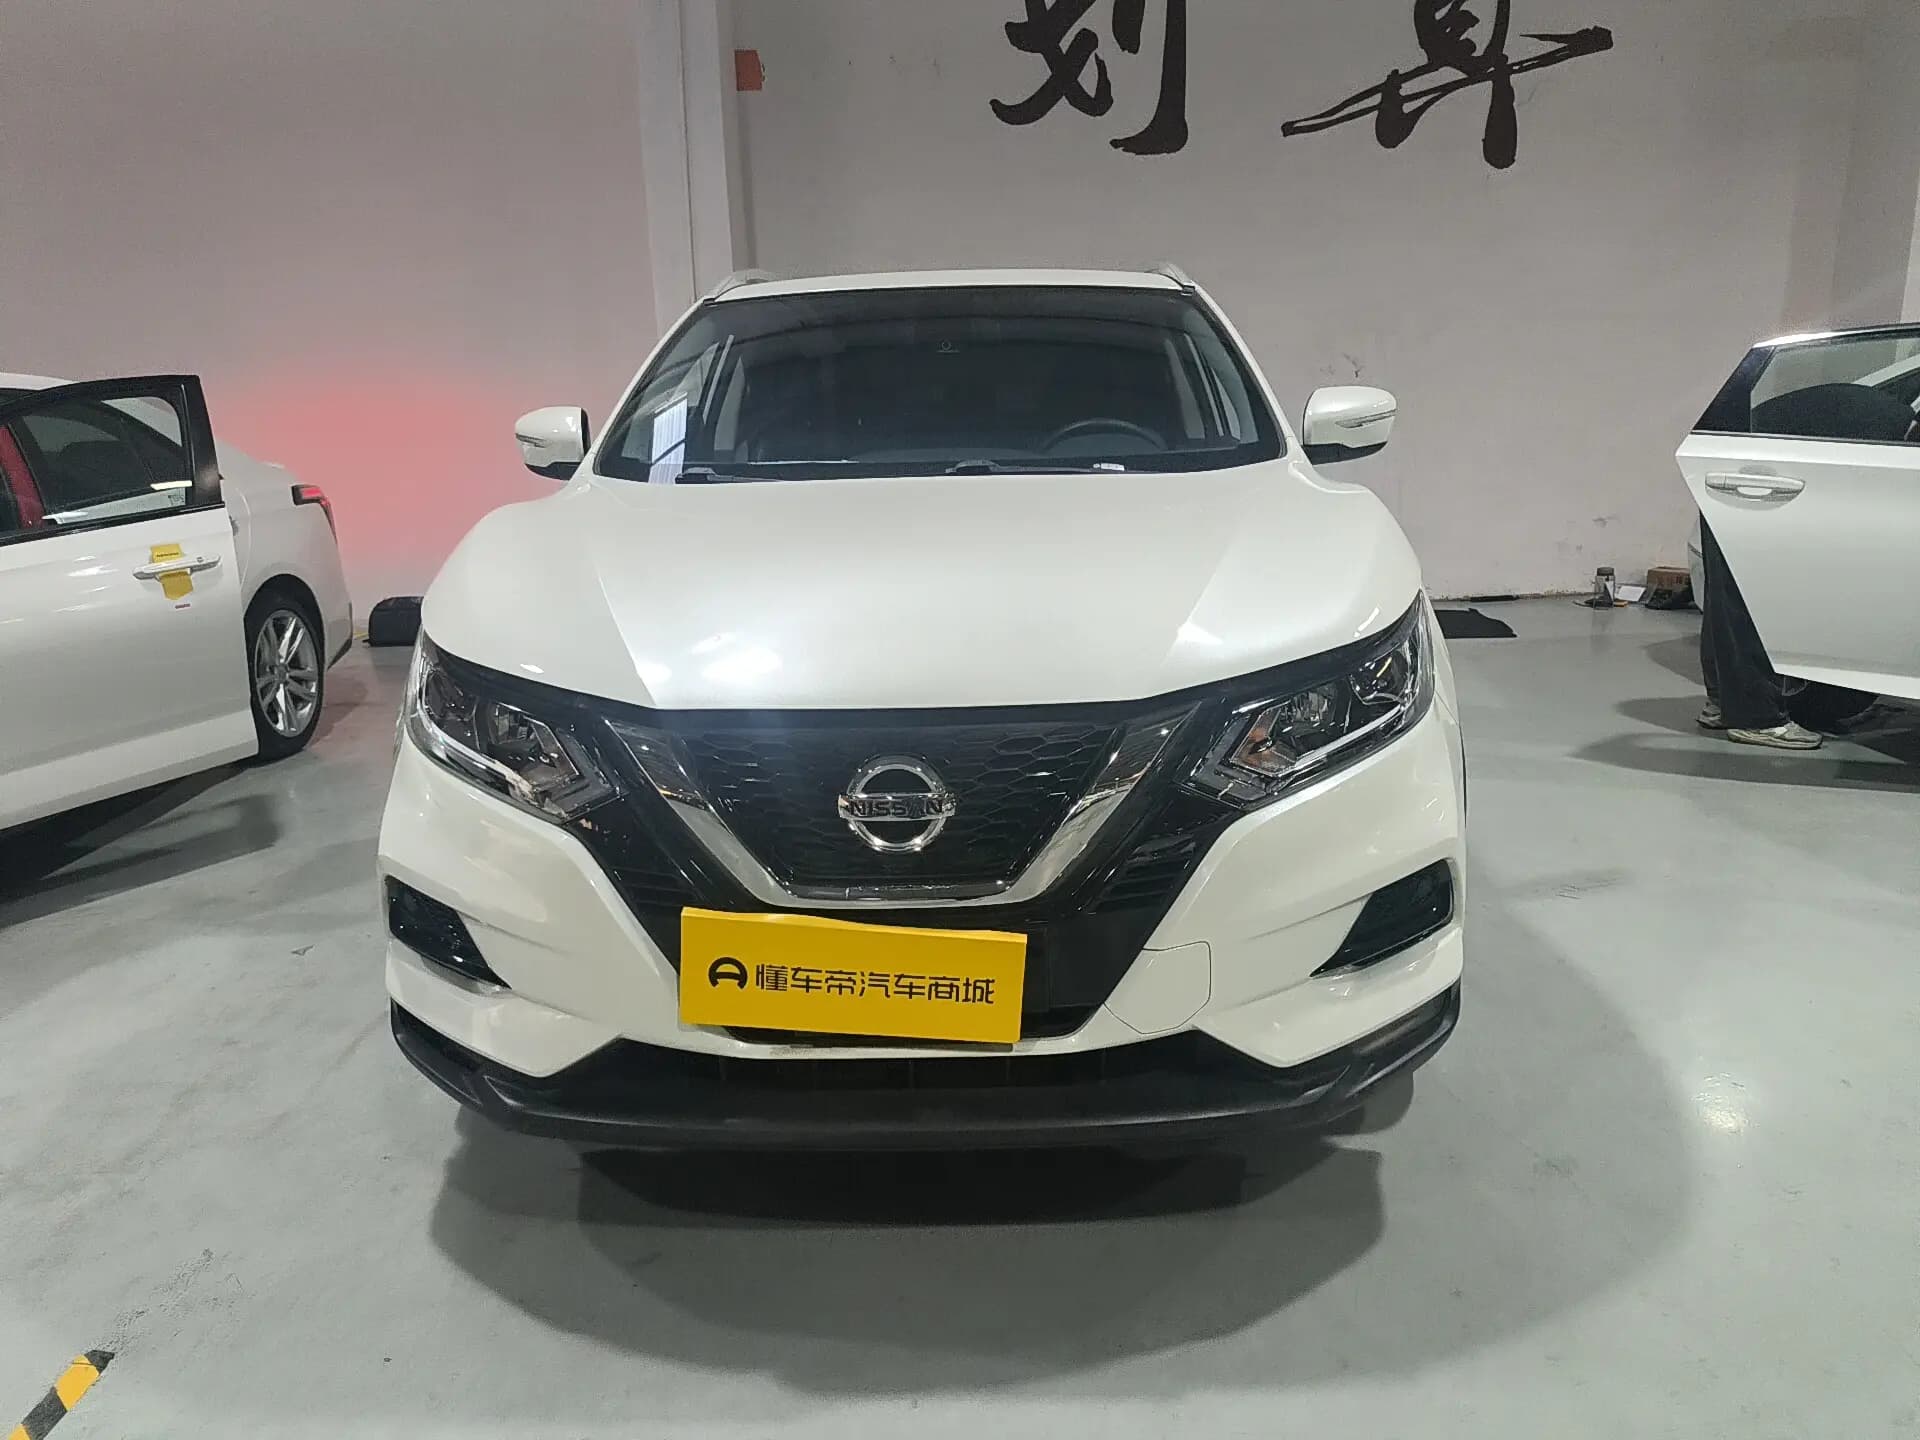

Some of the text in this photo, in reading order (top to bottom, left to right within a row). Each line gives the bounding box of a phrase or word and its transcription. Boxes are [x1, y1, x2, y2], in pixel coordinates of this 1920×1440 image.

[849, 799, 943, 817] NISSAN
[756, 963, 994, 1004] 懂车帝汽车商城
